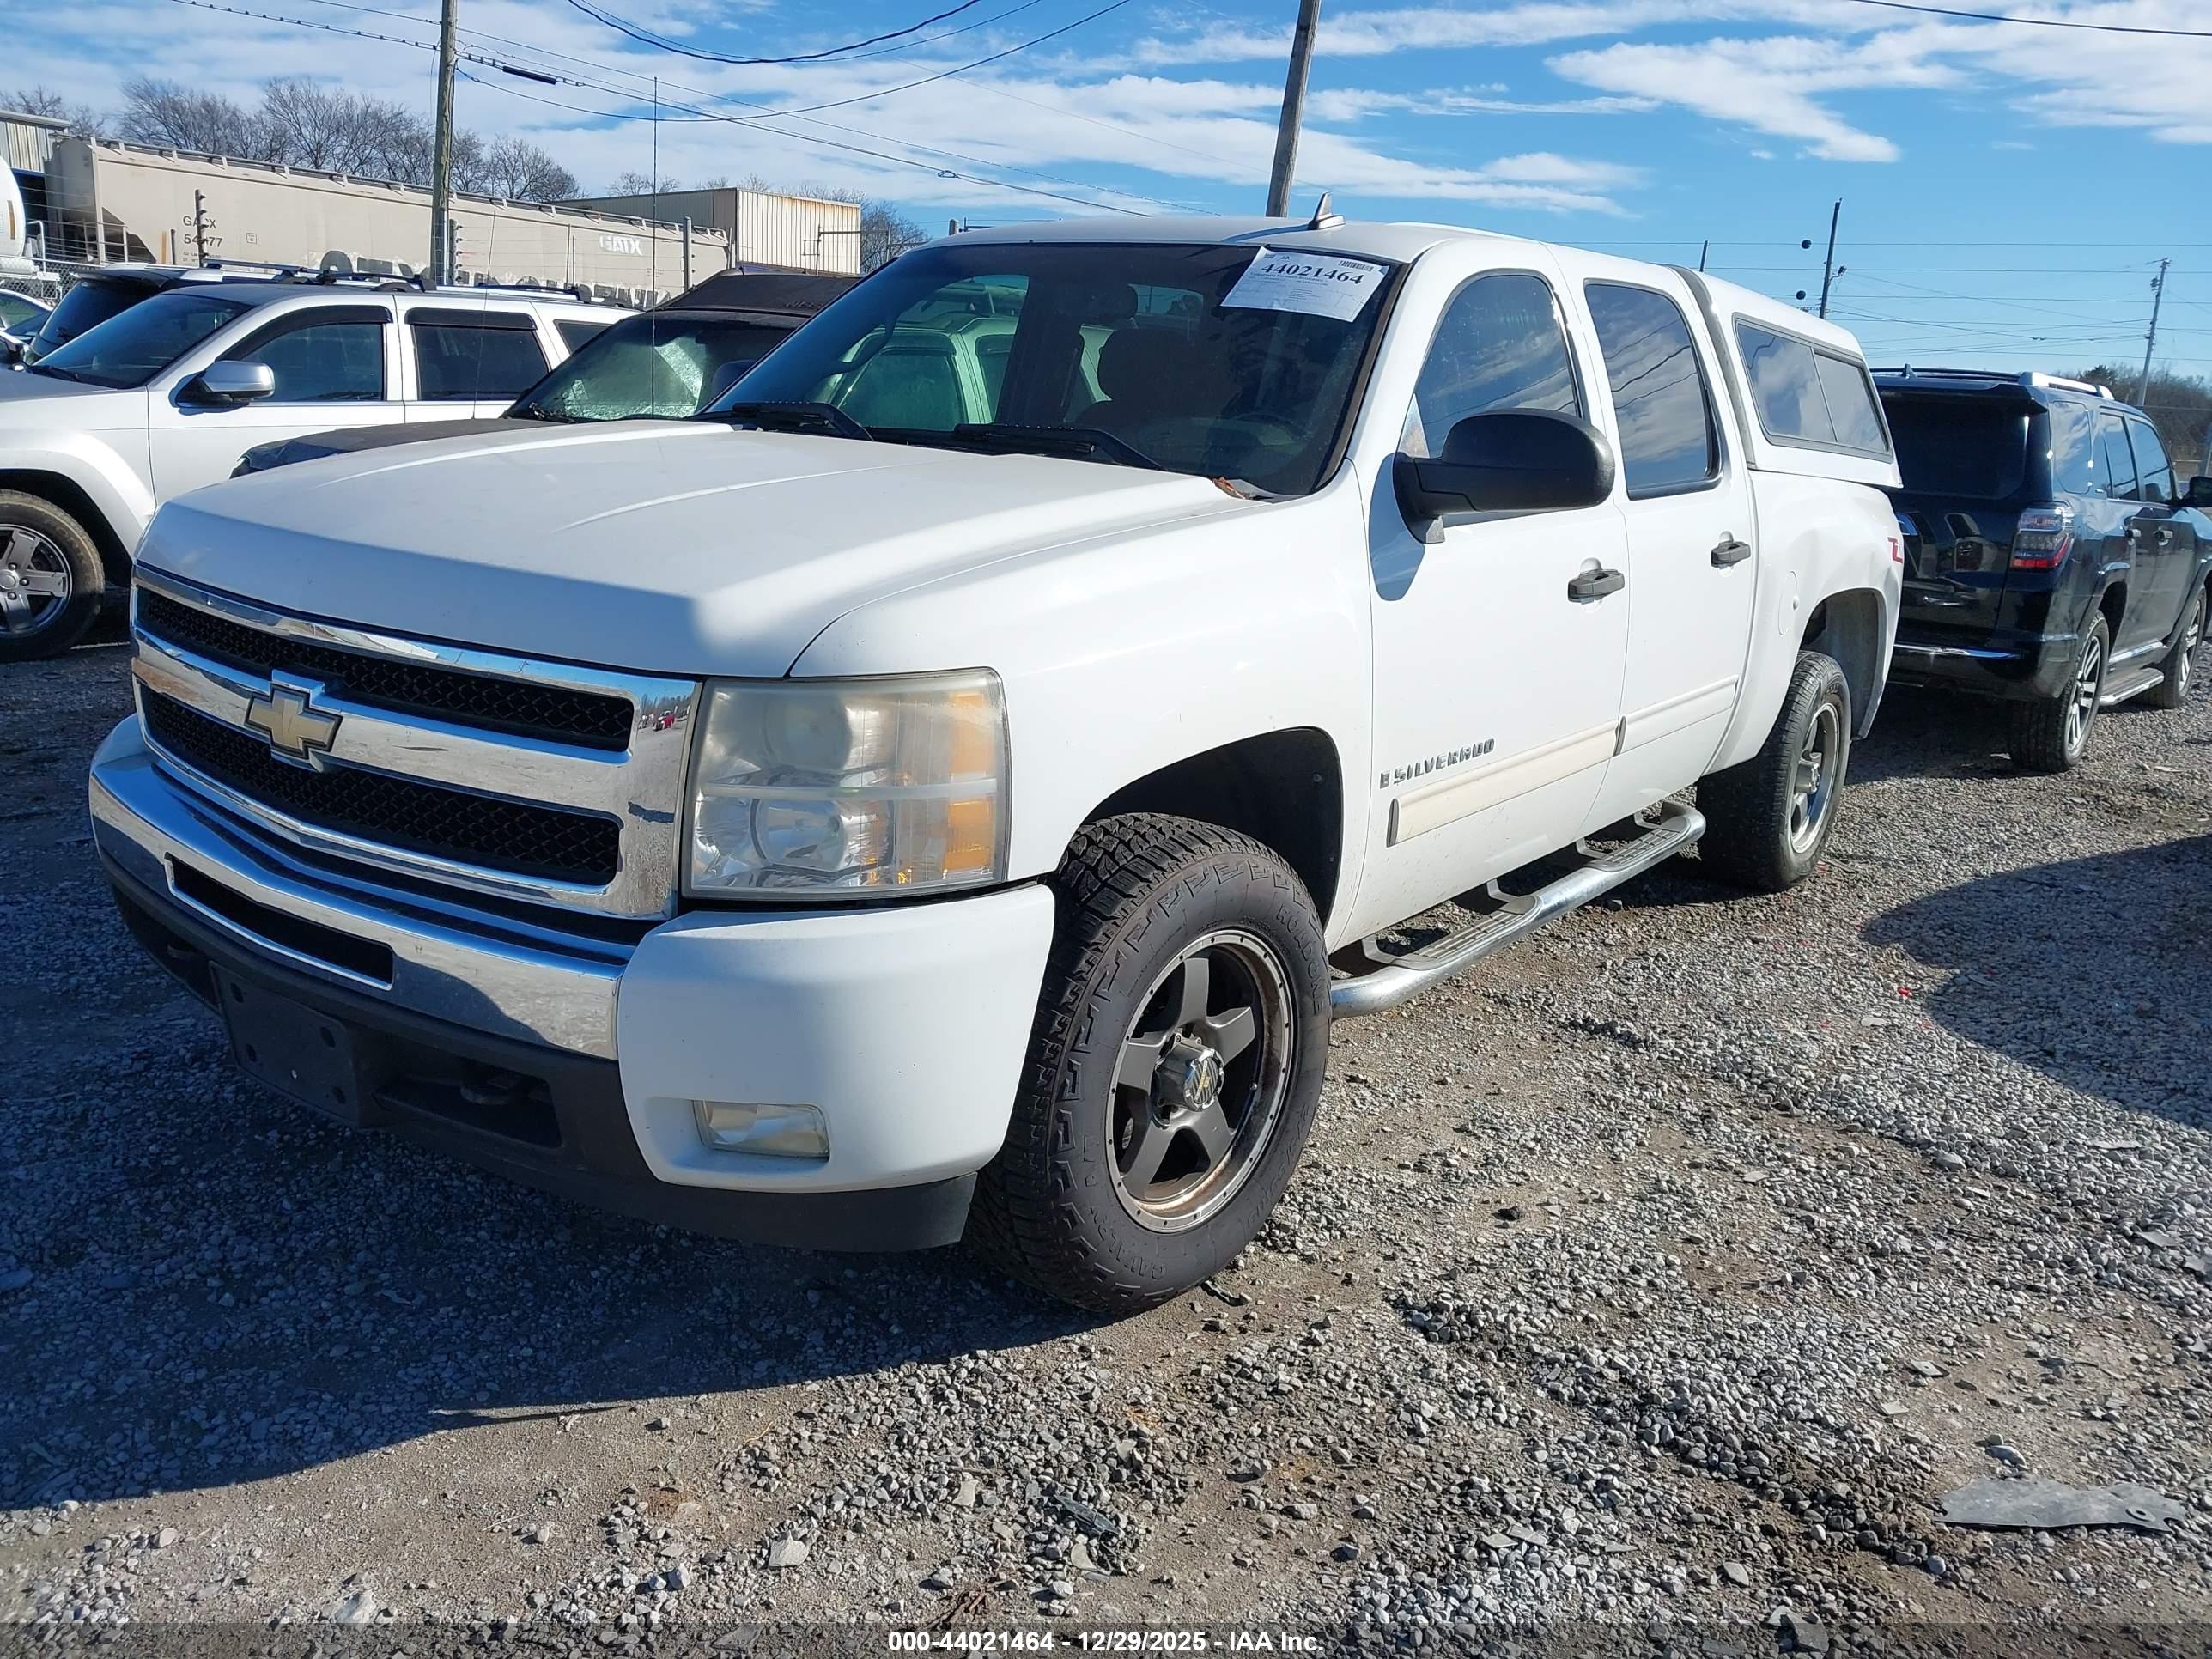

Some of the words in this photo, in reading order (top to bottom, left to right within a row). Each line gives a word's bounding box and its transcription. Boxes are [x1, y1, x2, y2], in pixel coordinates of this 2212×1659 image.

[183, 216, 216, 228] GAX
[184, 234, 222, 247] 5477
[599, 234, 643, 256] GATX
[1261, 263, 1364, 285] 44021464
[1393, 738, 1496, 785] SILVERADO
